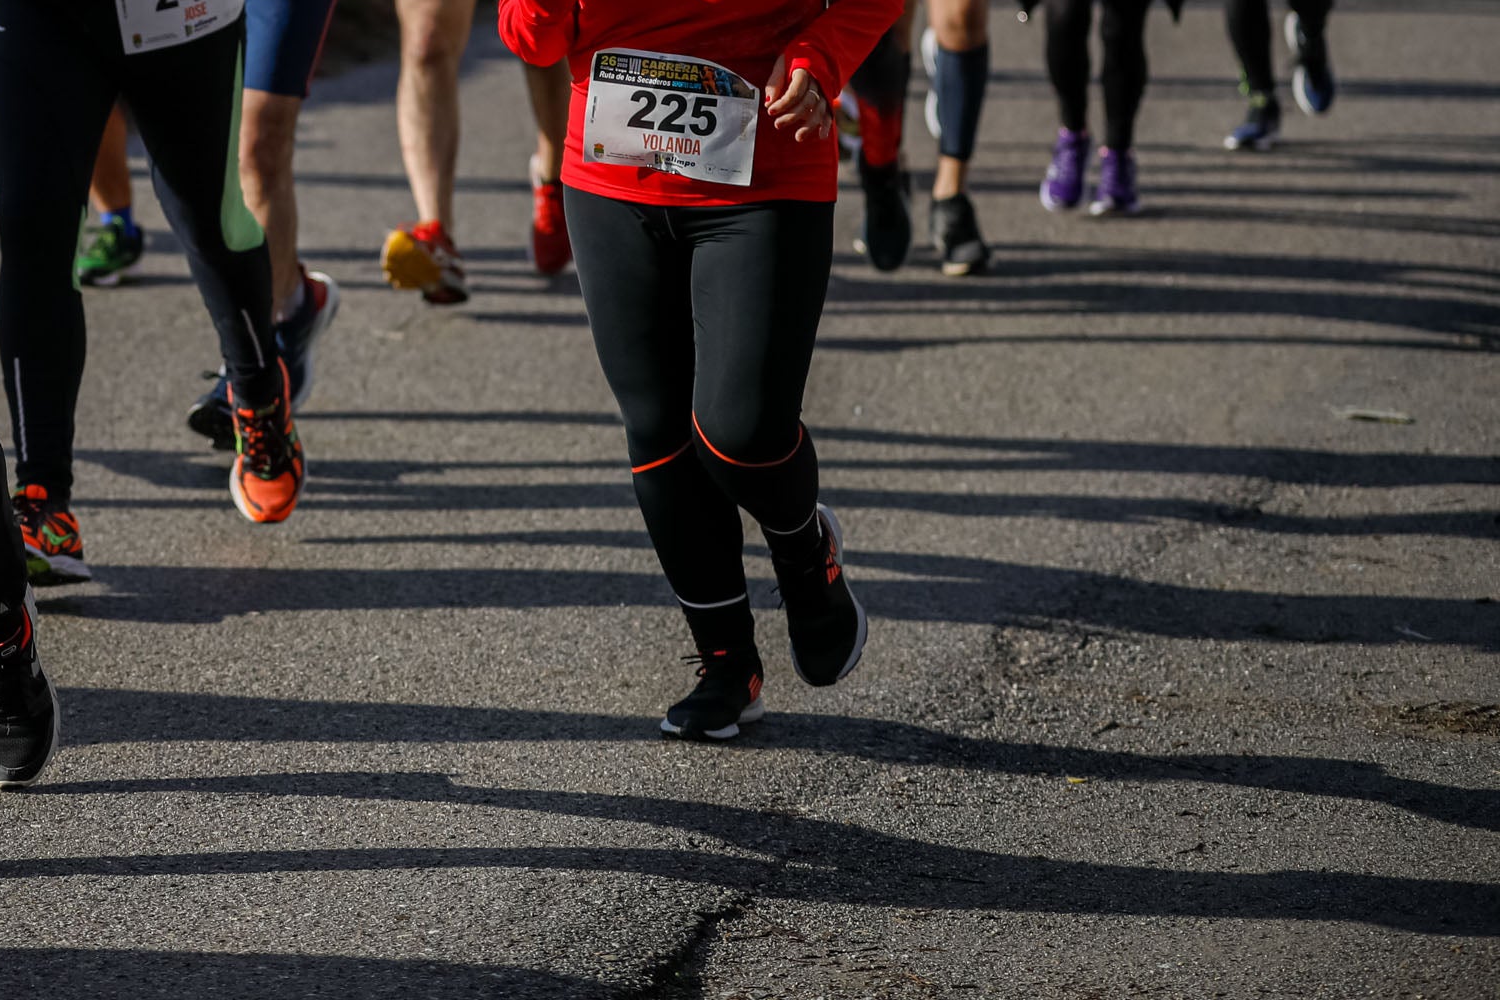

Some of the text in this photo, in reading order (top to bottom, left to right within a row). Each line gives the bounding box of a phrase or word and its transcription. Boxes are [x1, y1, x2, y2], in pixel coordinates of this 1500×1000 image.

[185, 1, 207, 21] JOSE
[600, 55, 617, 67] 26
[642, 59, 700, 74] CARRERA
[599, 70, 615, 80] Ruta
[616, 73, 625, 81] de
[625, 74, 636, 83] los
[637, 76, 671, 87] Secaderos
[641, 69, 699, 82] POPULAR
[627, 90, 718, 137] 225
[643, 133, 701, 156] YOLANDA
[665, 155, 696, 167] olimpo
